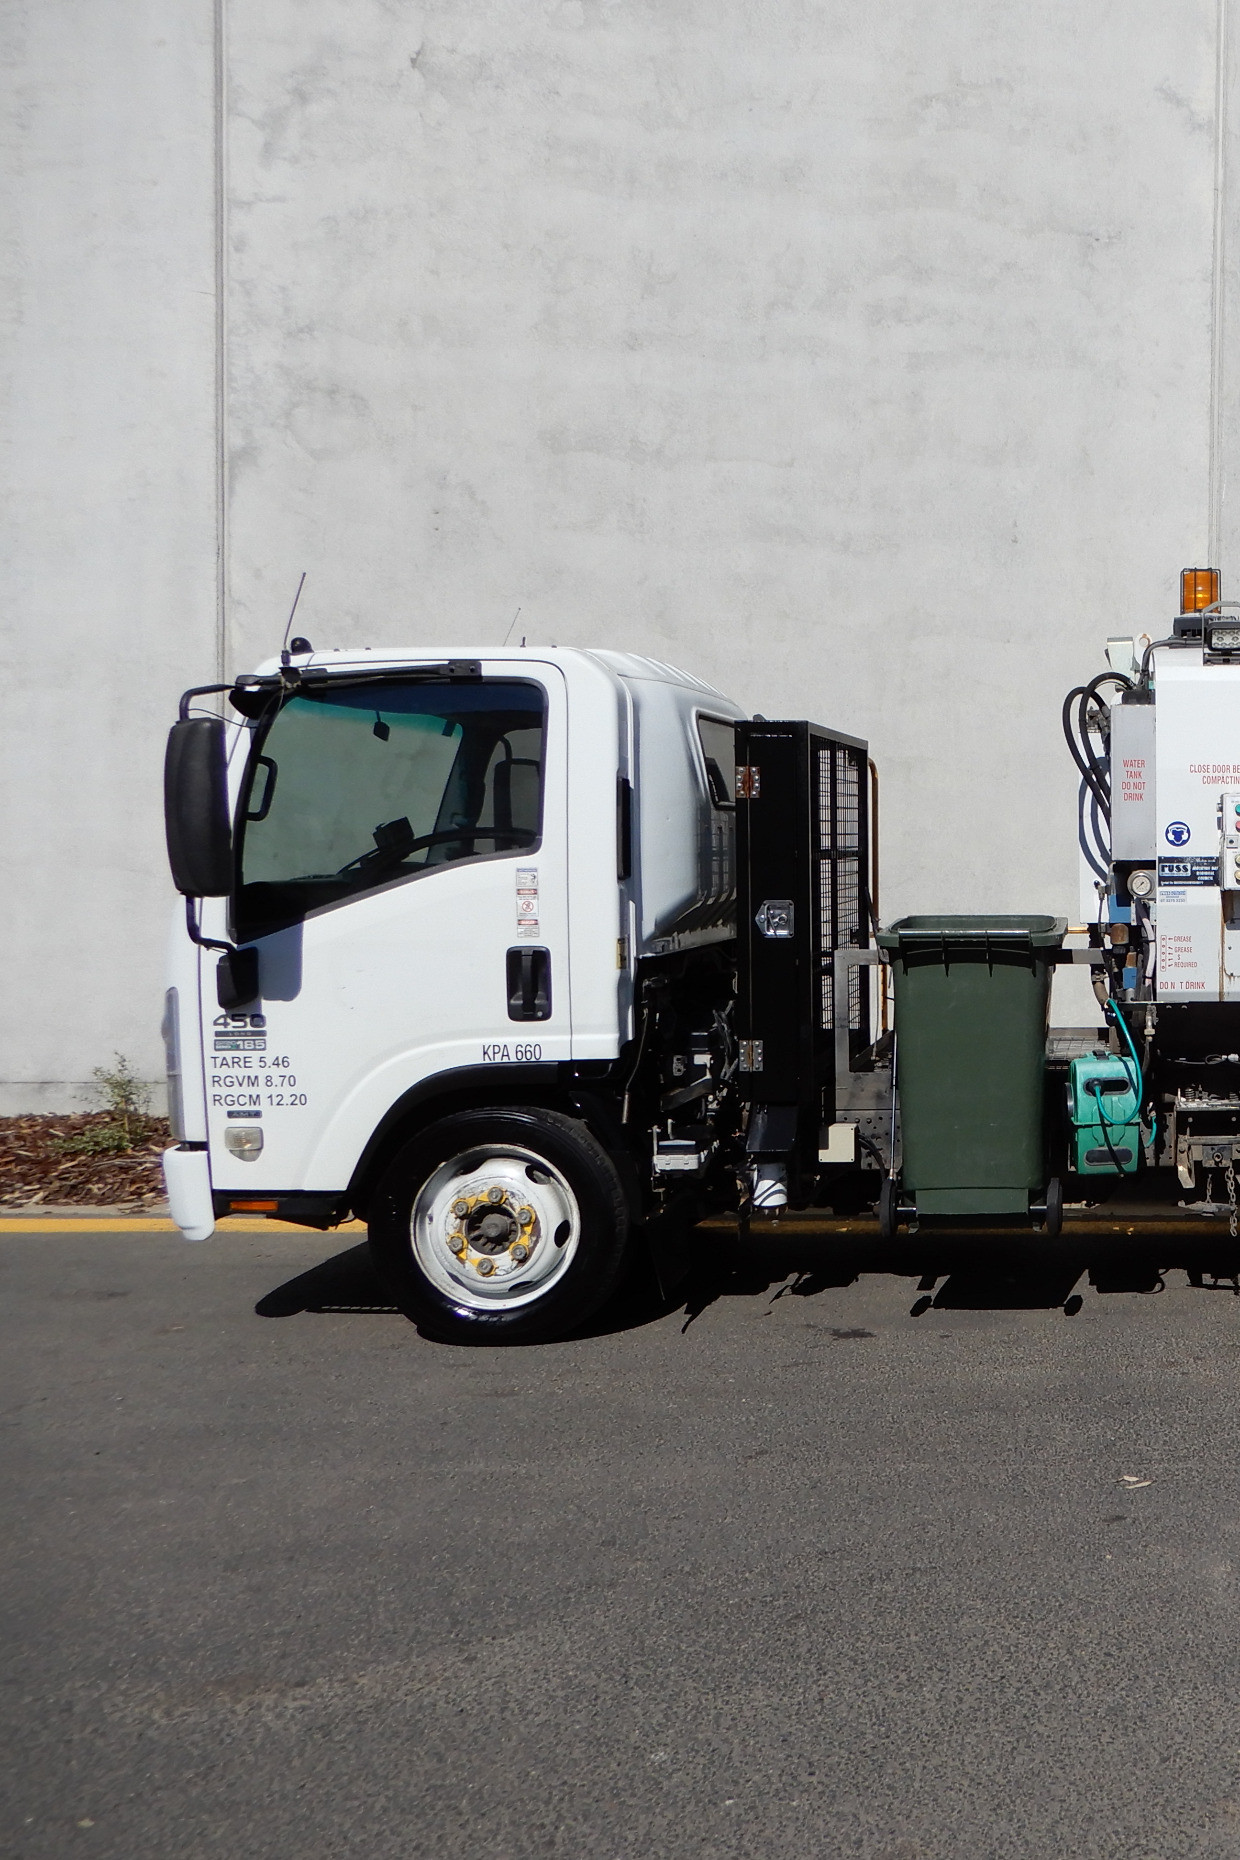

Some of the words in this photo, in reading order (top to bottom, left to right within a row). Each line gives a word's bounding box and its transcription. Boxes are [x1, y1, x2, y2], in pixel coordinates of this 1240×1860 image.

[1122, 760, 1146, 768] WATER
[1189, 764, 1210, 774] CLOSE
[1212, 764, 1231, 774] DOOR
[1126, 770, 1142, 779] TANK
[1122, 782, 1131, 790] DO
[1132, 782, 1146, 790] NOT
[1123, 793, 1144, 801] DRINK
[212, 1013, 267, 1028] 450
[237, 1040, 265, 1050] 185
[482, 1044, 511, 1062] KPA
[515, 1044, 542, 1061] 660
[210, 1056, 253, 1068] TARE
[258, 1056, 290, 1068] 5.46
[212, 1075, 260, 1087] RGVM
[265, 1075, 296, 1087] 8.70
[212, 1094, 261, 1106] RGCM
[267, 1094, 308, 1106] 12.20
